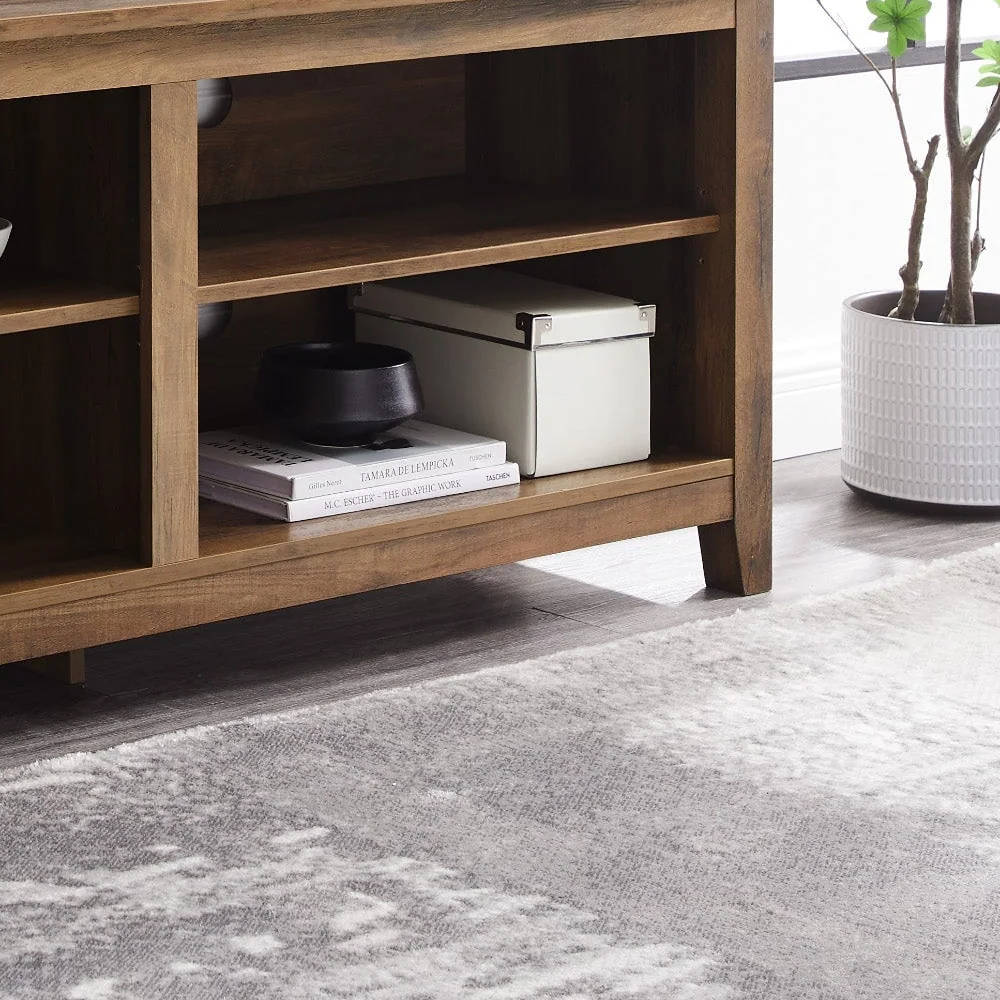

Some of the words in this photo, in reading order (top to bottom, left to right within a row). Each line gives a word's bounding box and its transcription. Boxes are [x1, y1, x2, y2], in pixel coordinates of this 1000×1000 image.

[360, 467, 397, 482] TAMARA
[398, 464, 409, 476] DE
[411, 457, 455, 474] LEMPICKA
[486, 471, 511, 482] TASCHEN
[324, 499, 341, 510] M.C.
[383, 489, 400, 500] THE
[401, 483, 437, 497] GRAPHIC
[437, 479, 462, 491] WORK
